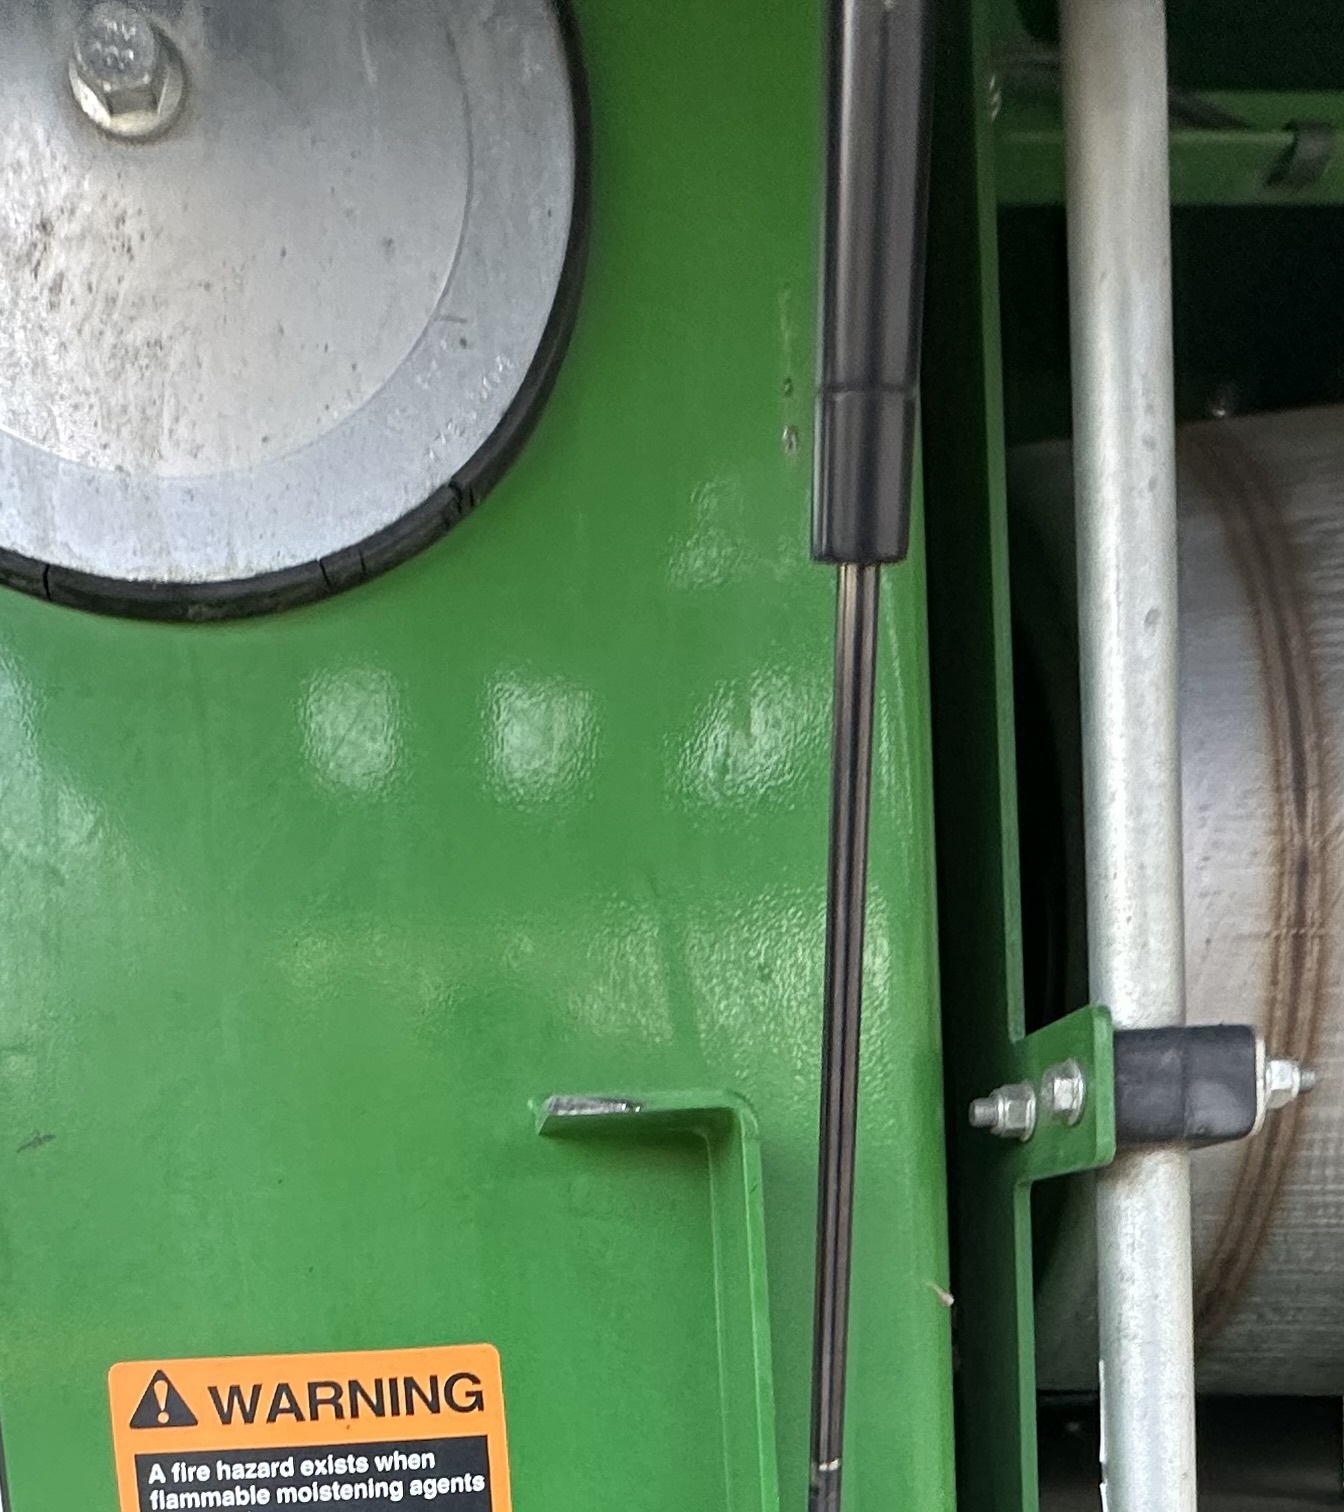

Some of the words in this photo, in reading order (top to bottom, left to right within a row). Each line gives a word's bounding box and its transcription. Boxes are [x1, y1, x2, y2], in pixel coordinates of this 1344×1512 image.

[208, 1372, 484, 1425] WARNING
[148, 1463, 166, 1484] A
[171, 1462, 210, 1483] fire
[216, 1457, 294, 1480] hazard
[300, 1454, 369, 1476] exists
[374, 1451, 435, 1472] when
[150, 1485, 270, 1510] flammable
[276, 1478, 403, 1503] moistening
[410, 1473, 485, 1499] agents
